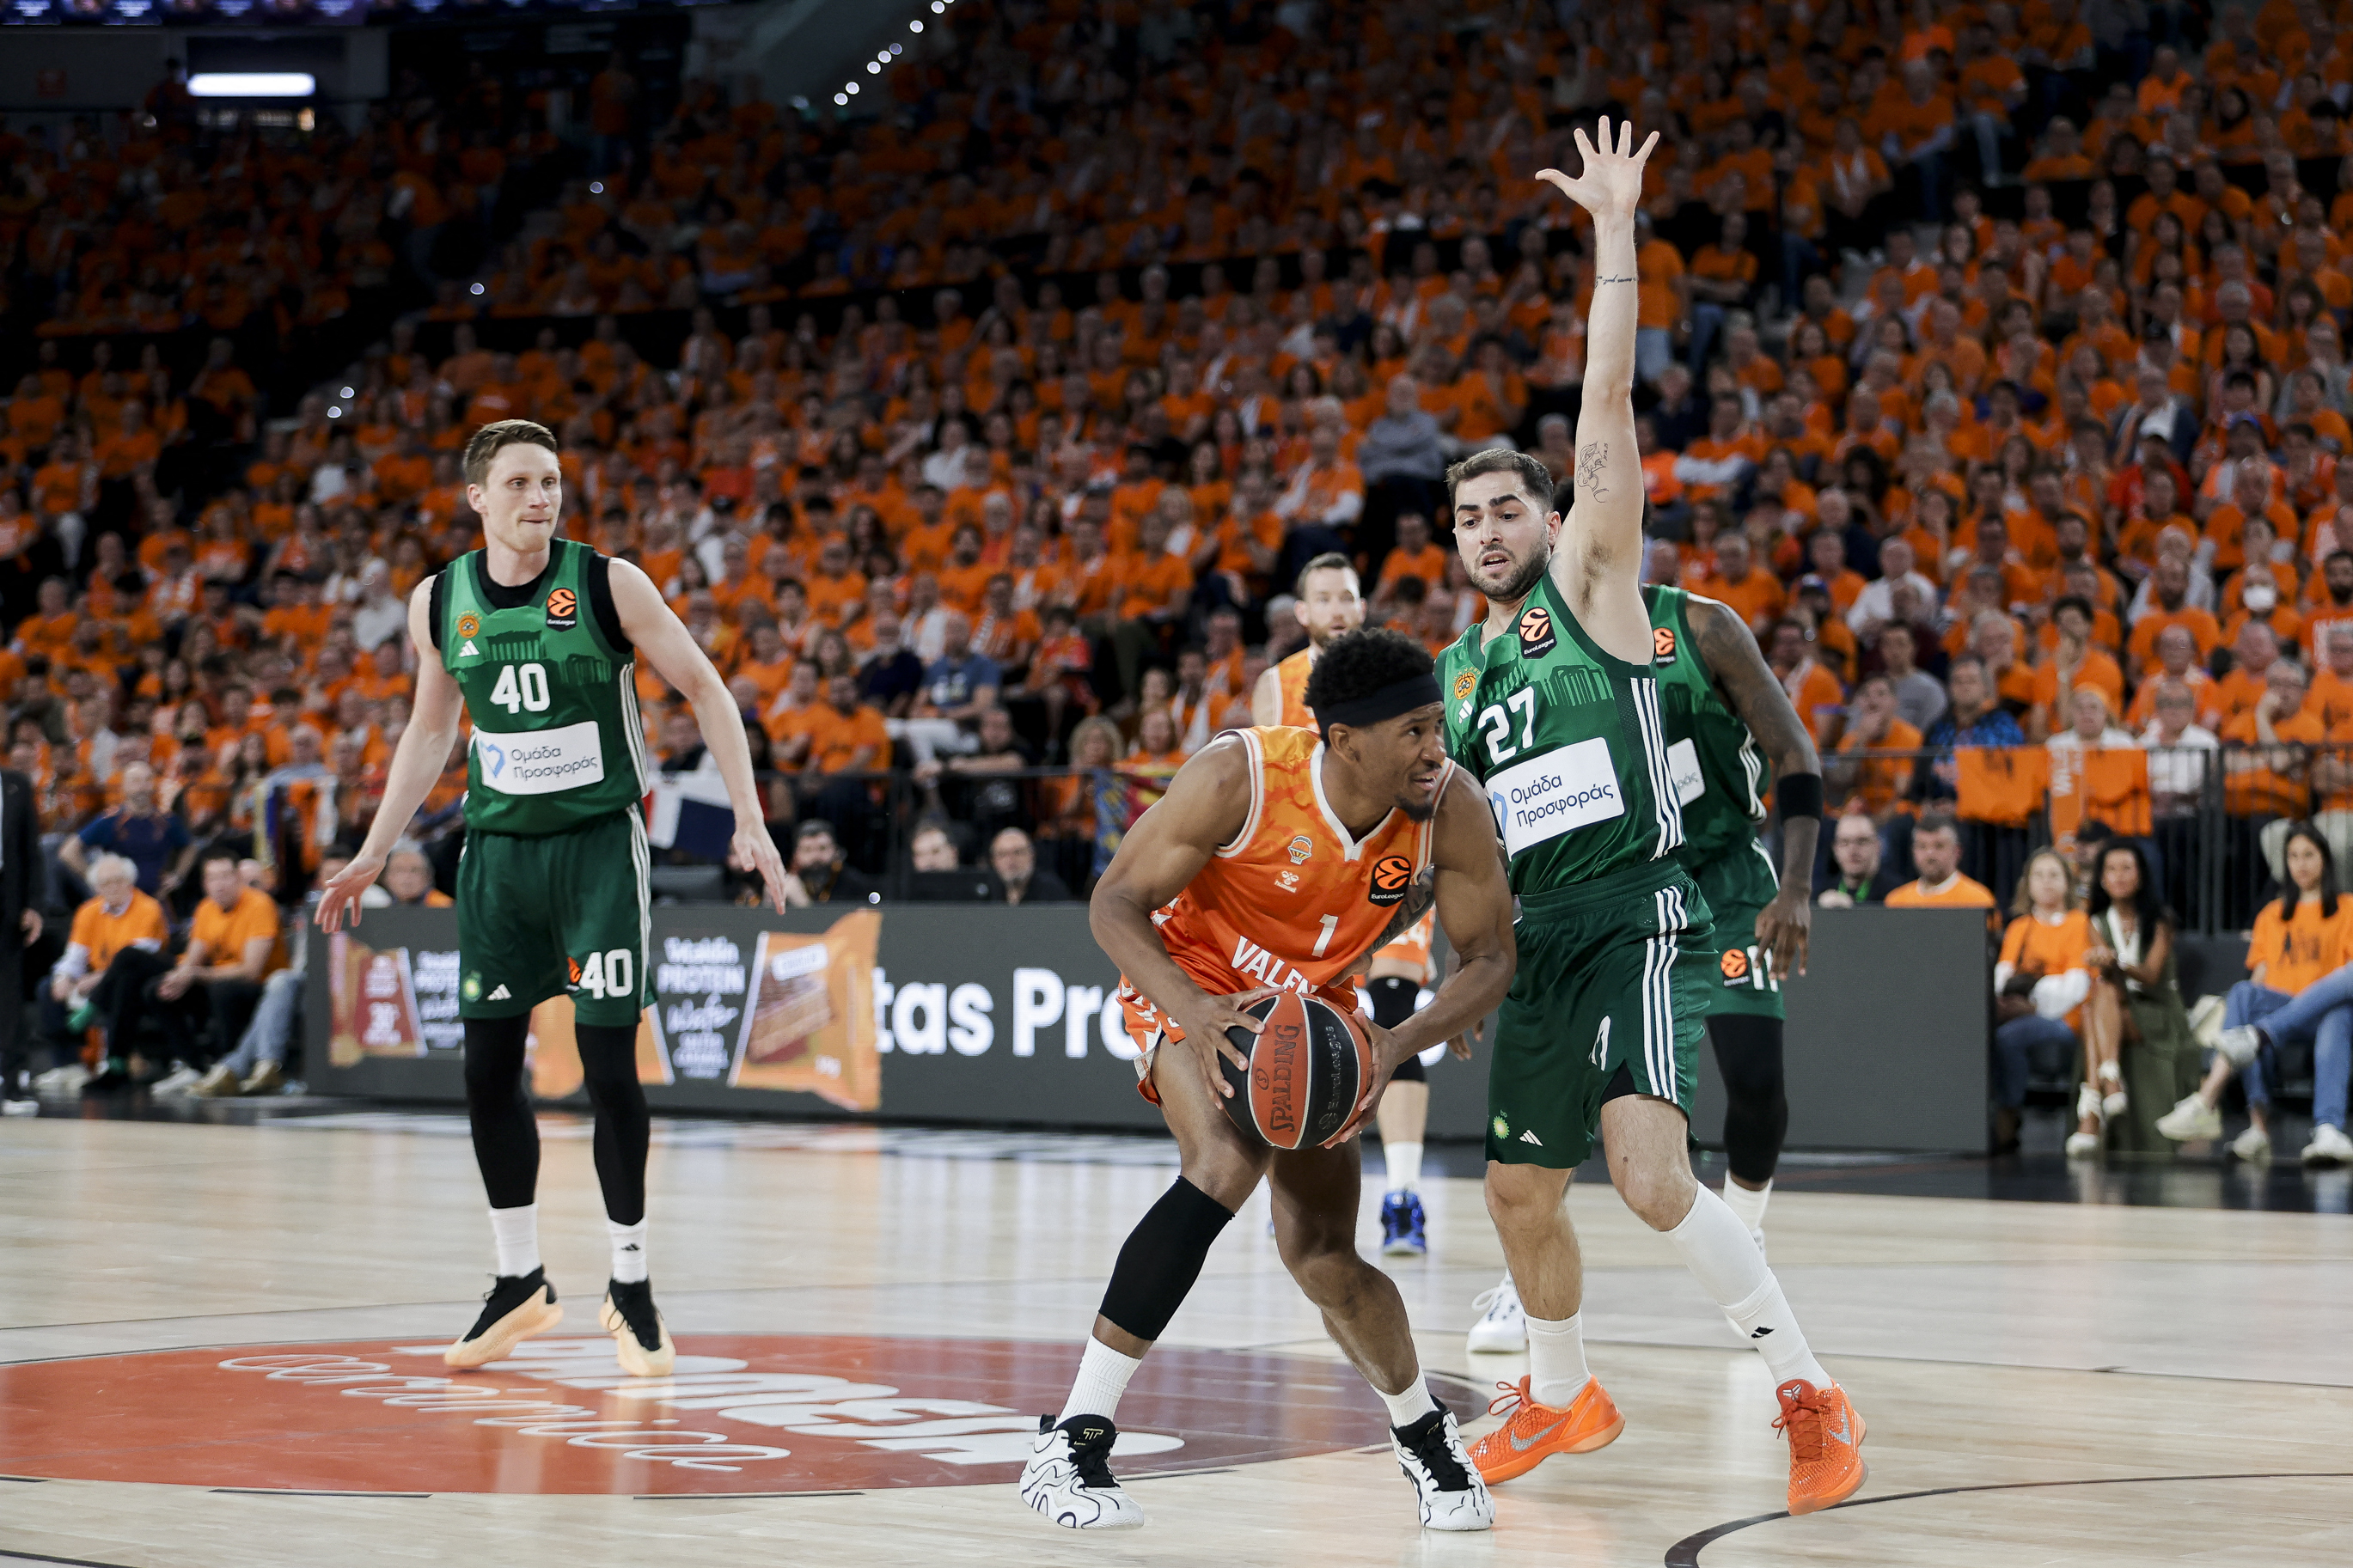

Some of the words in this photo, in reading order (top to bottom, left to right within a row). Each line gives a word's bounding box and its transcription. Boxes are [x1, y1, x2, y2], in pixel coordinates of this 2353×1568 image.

[1524, 638, 1555, 655] EuroLeague
[490, 662, 551, 715] 40
[1477, 686, 1535, 766] 27
[511, 745, 562, 763] Ομάδα
[513, 755, 598, 781] Προσφοράς
[1510, 774, 1563, 804] Ομάδα
[1516, 783, 1614, 828] Προσφοράς
[1311, 913, 1339, 959] 1
[579, 948, 633, 1000] 40
[1269, 1024, 1301, 1132] SPALDING
[1325, 1025, 1342, 1110] EuroLeague
